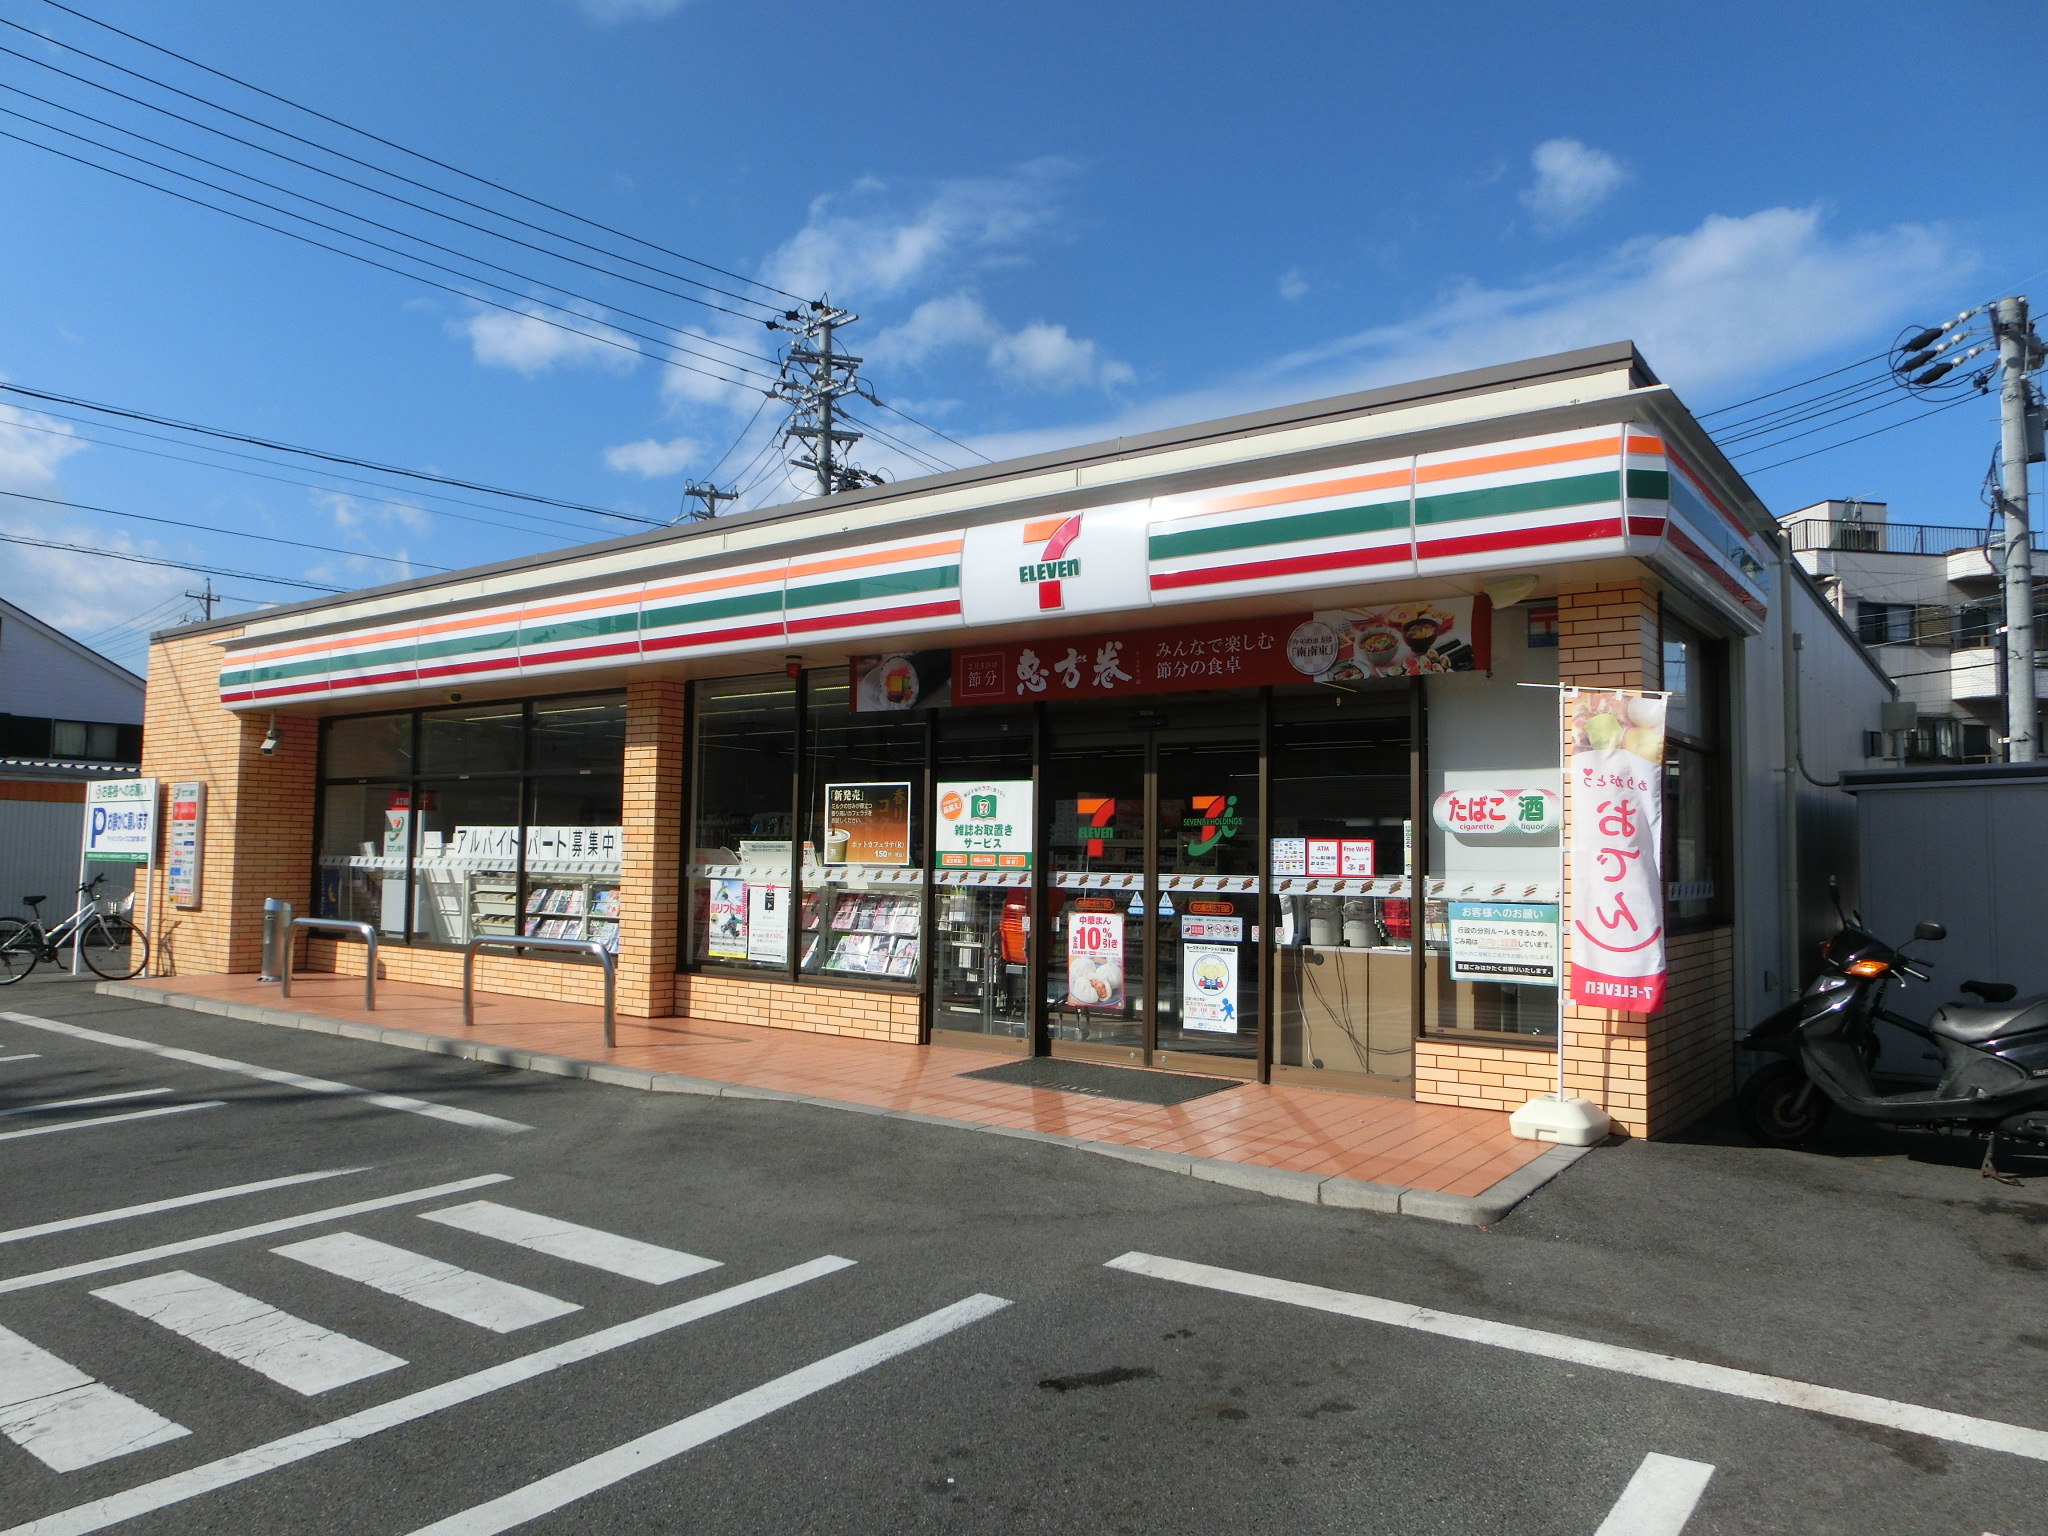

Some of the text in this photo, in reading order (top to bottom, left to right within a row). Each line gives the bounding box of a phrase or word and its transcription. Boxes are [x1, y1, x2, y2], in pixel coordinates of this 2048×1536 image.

[1019, 514, 1081, 610] 7 ELEVEN
[1156, 632, 1275, 658] みんなで楽しむ
[1291, 645, 1333, 658] 「南南東」
[1016, 641, 1133, 695] 恵方巻
[1156, 656, 1241, 680] 節分の食卓
[968, 670, 998, 688] 節分
[830, 789, 864, 801] 「新発売」
[1449, 795, 1544, 822] たばこ 酒
[1077, 798, 1116, 857] 7
[1210, 817, 1243, 826] HOLDINGS
[1460, 823, 1495, 832] cigarette
[954, 823, 1013, 836] 雑誌お取置き
[1078, 827, 1114, 839] ELEVEN
[456, 829, 519, 855] アルバイト
[964, 838, 1002, 849] サービス
[1461, 907, 1544, 919] お客様へのお願い
[1079, 915, 1112, 926] 中華まん
[1457, 926, 1548, 937] 行政の分別ルールを守るため、
